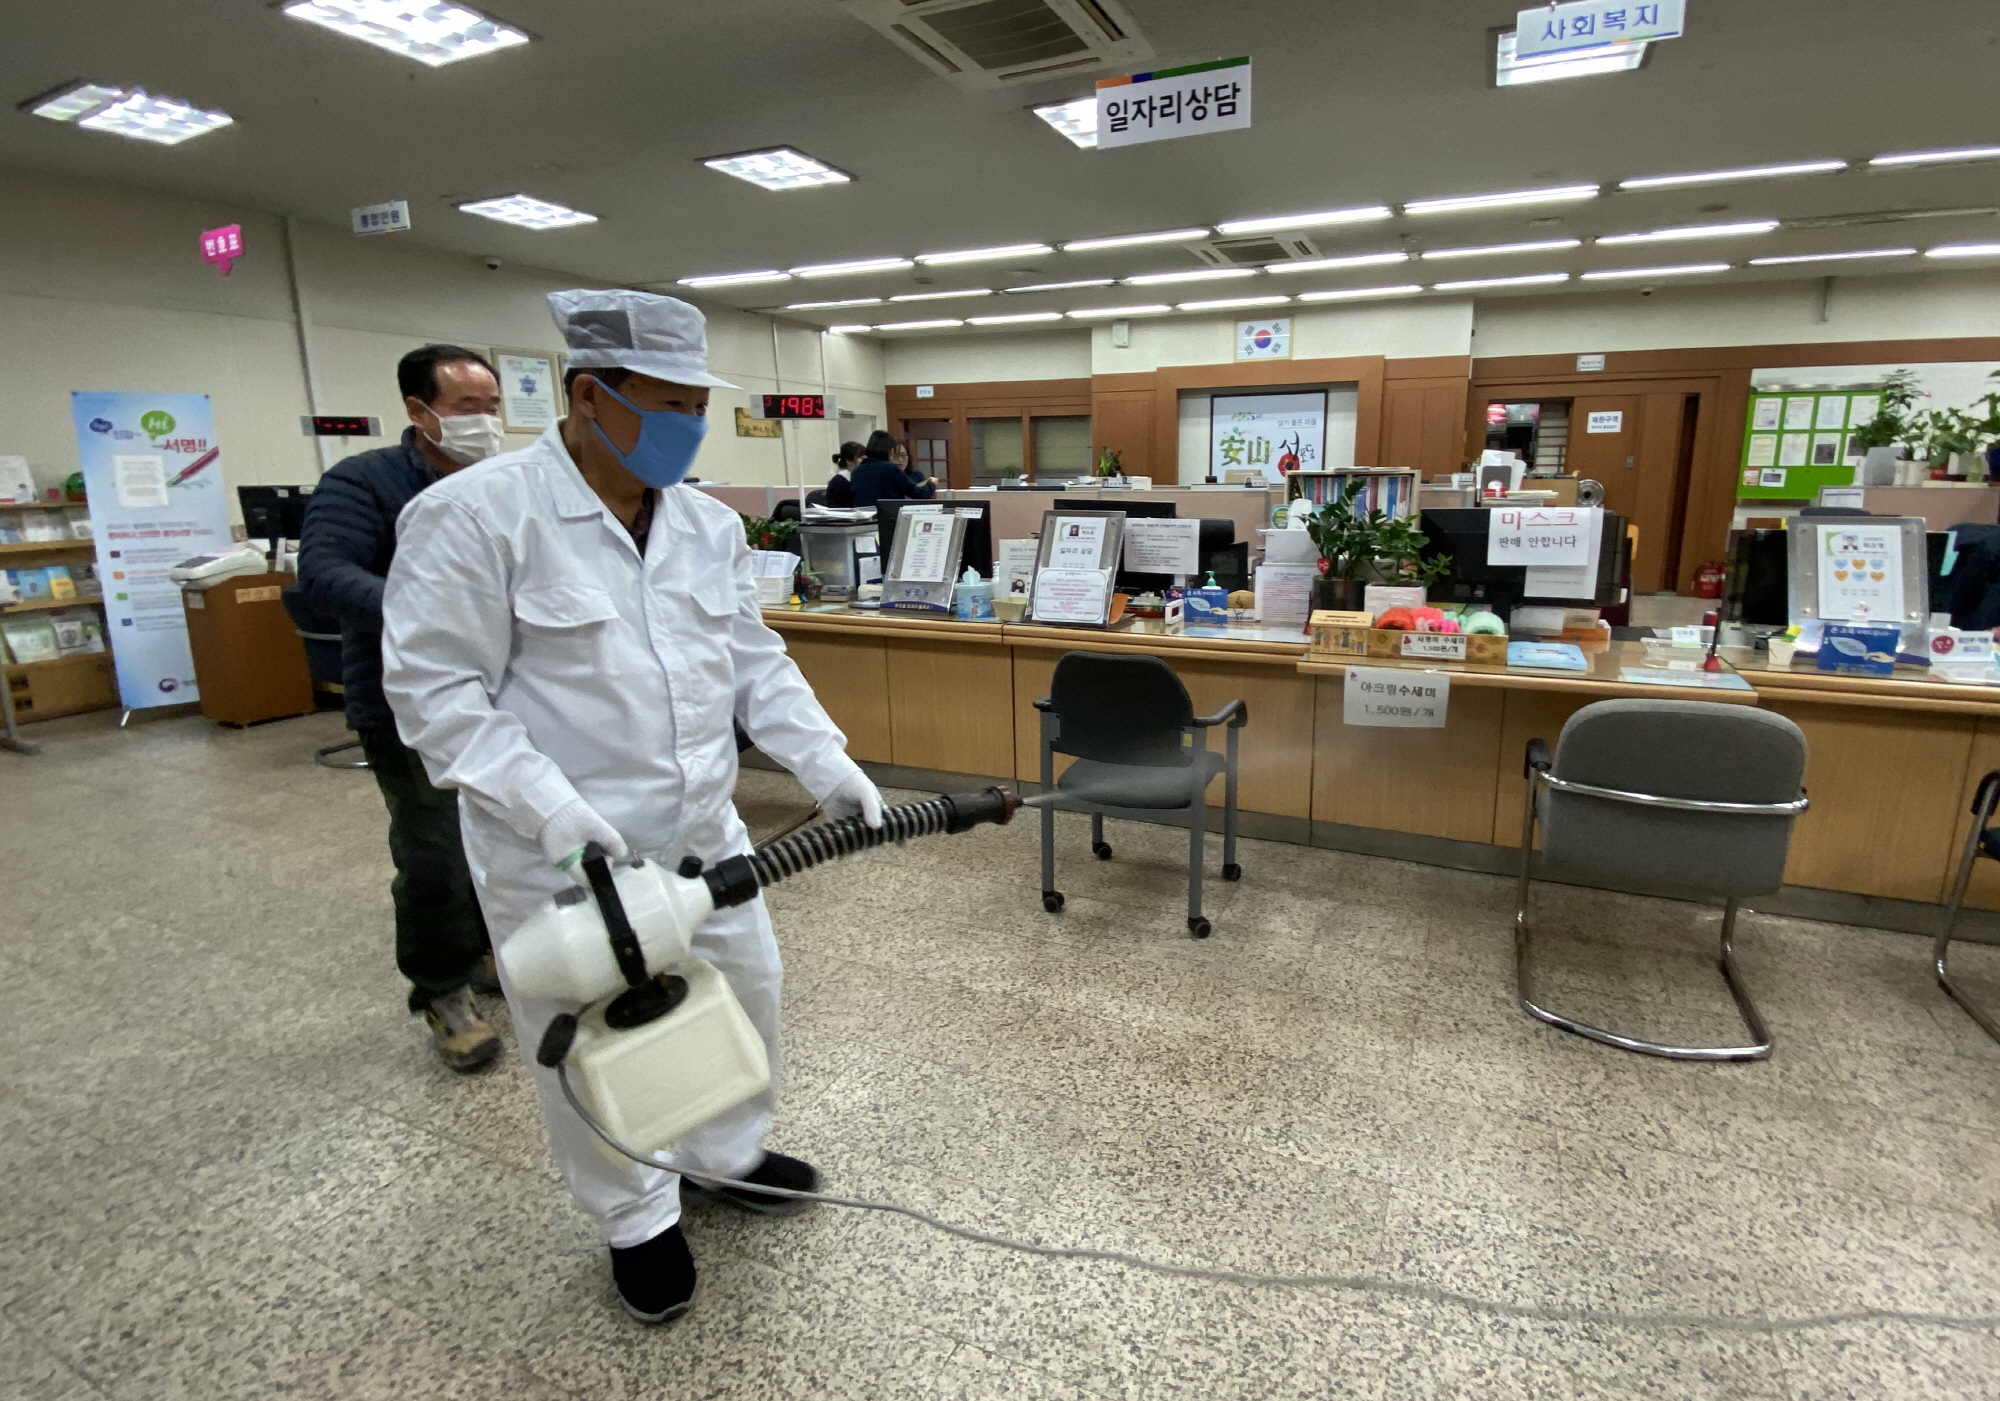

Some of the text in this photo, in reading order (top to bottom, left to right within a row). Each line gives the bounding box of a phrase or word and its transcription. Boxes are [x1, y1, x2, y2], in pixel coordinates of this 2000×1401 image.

[1540, 4, 1659, 42] 사회복지
[1106, 82, 1241, 133] 일자리상담
[205, 233, 240, 257] 번호표
[781, 397, 814, 416] 198
[1291, 419, 1304, 427] 좋은
[163, 437, 207, 453] 서명!!
[1219, 435, 1271, 467] 安山
[1501, 511, 1578, 531] 마스크
[1498, 535, 1578, 549] 판매 안합니다
[1417, 635, 1465, 645] 사랑의 수세미
[1360, 681, 1437, 699] 아크릴수세미
